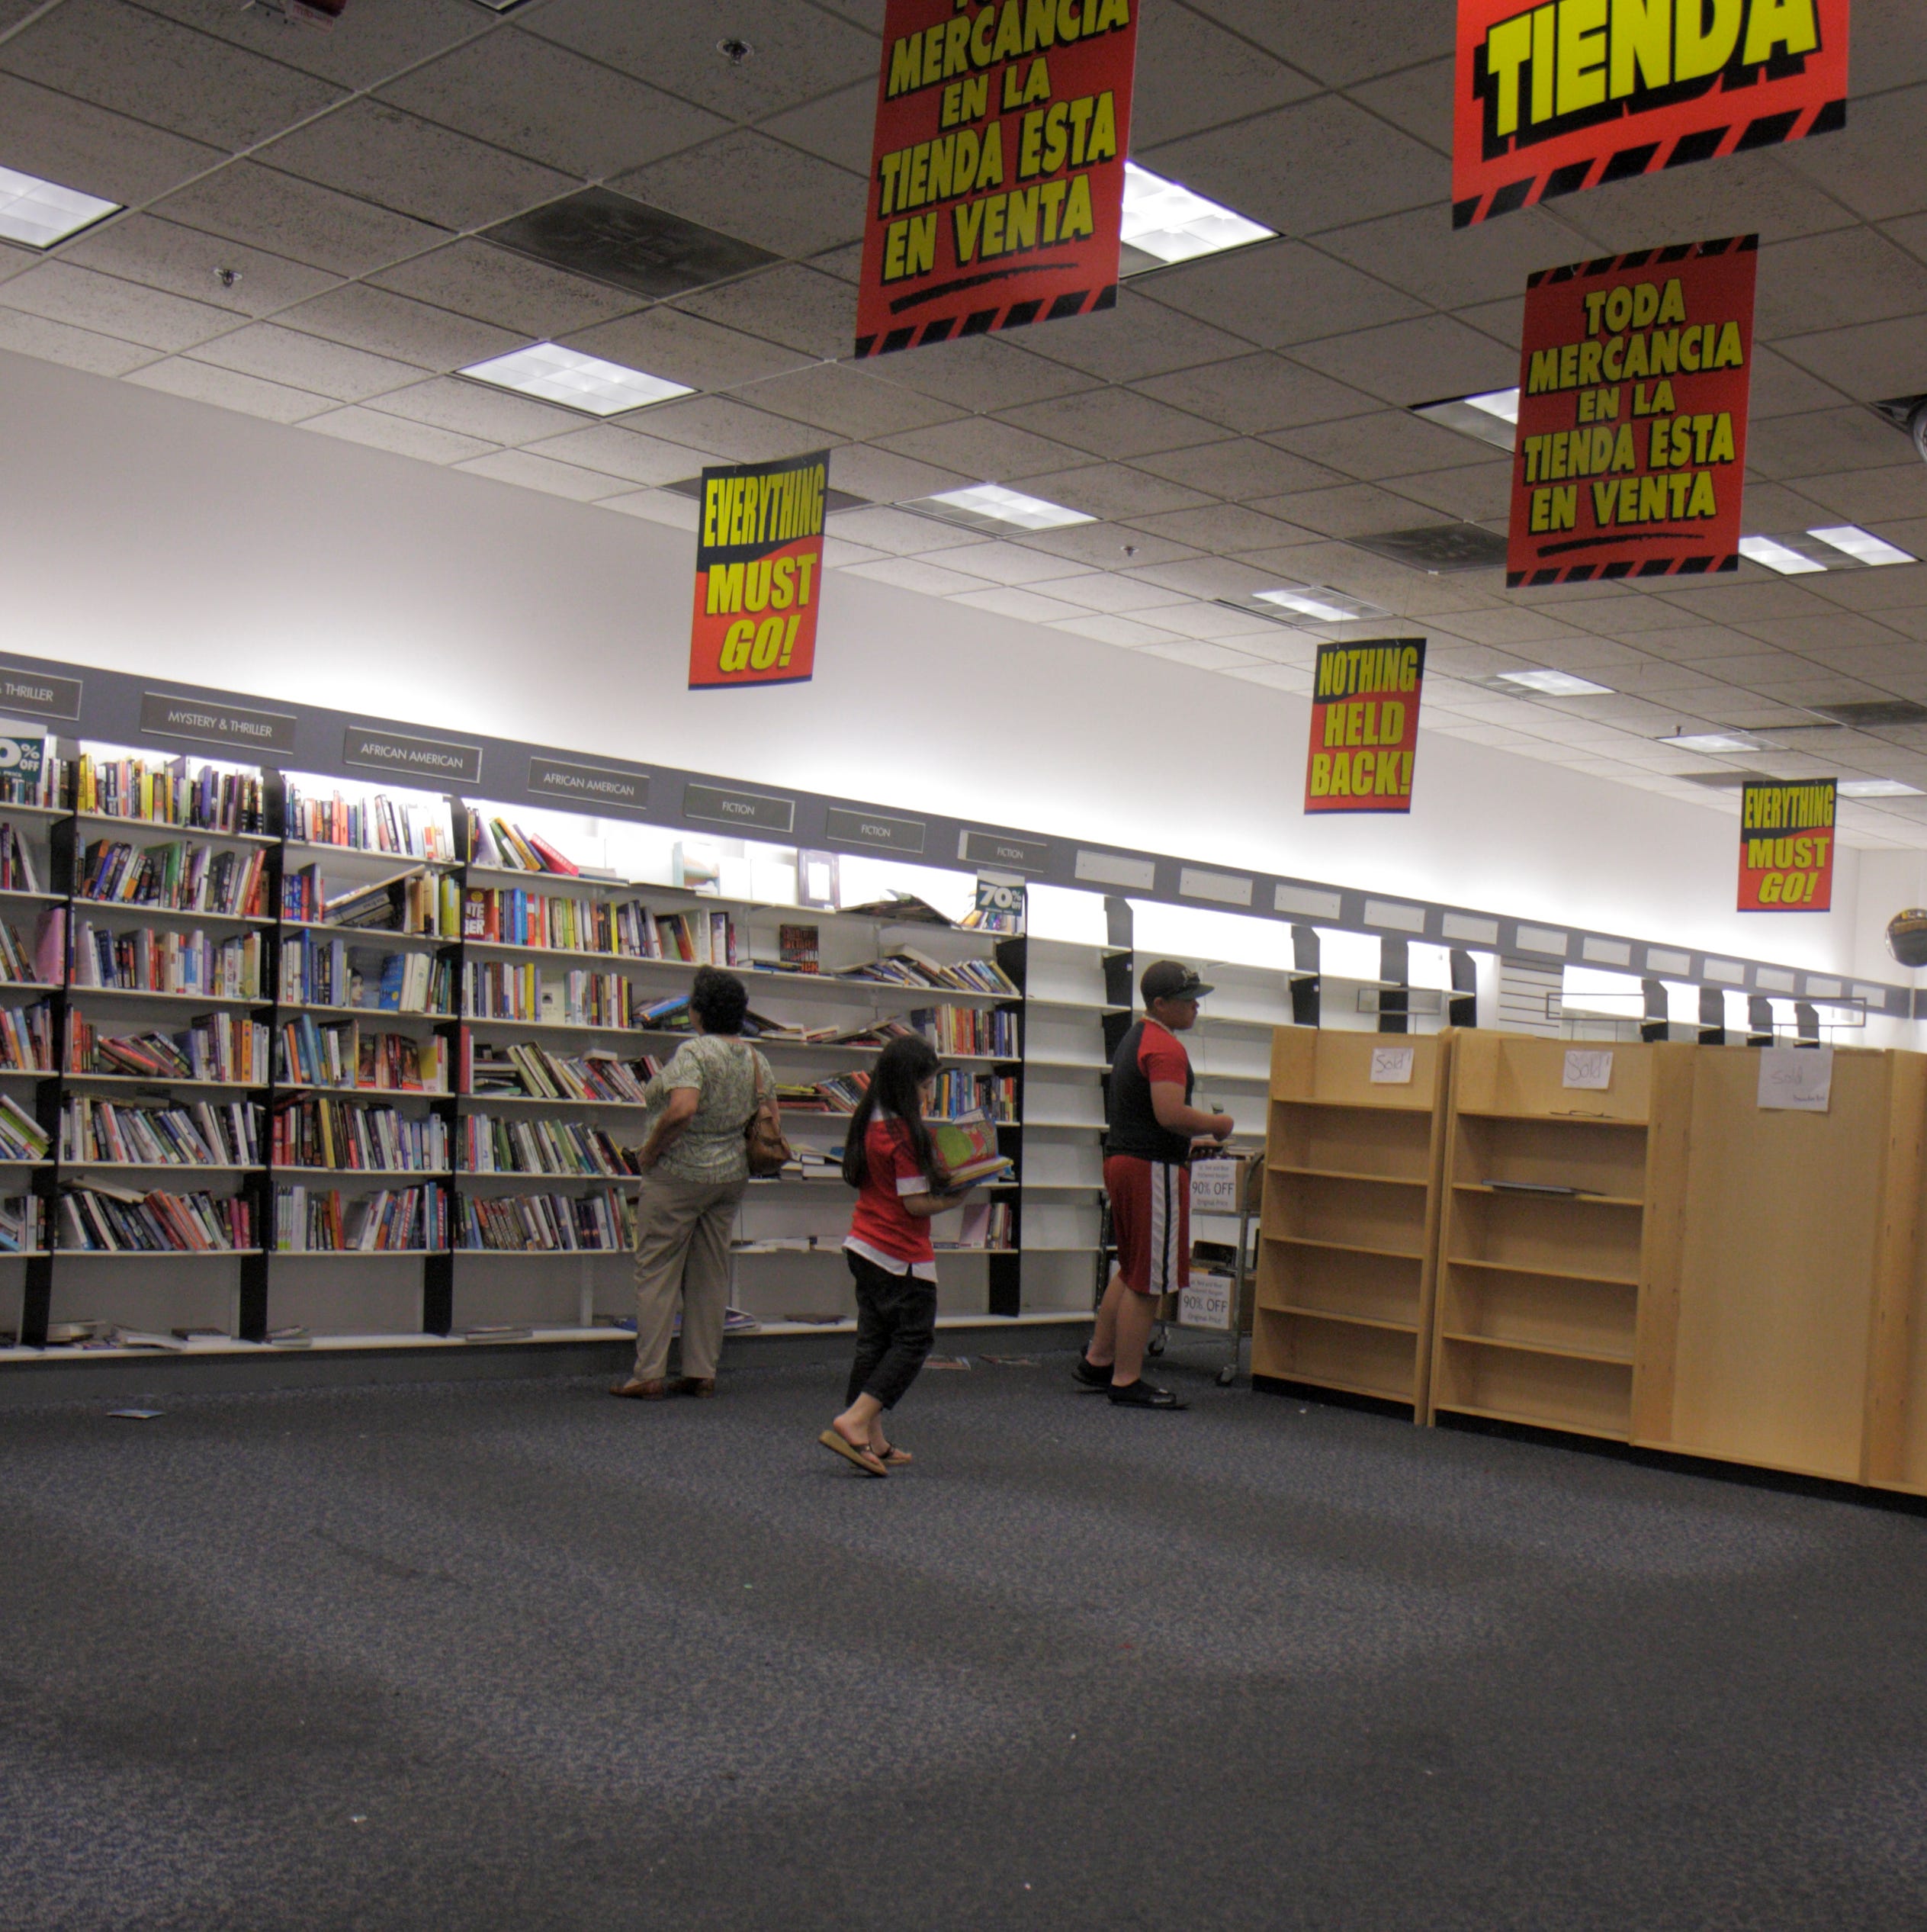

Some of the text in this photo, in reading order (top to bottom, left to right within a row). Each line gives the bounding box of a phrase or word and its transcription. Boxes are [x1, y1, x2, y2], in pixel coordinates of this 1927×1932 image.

[887, 0, 1130, 96] MERCANCIA
[941, 57, 1052, 129] EN LA
[1476, 0, 1819, 156] TIENDA
[879, 91, 1117, 217] TIENDA ESTA
[882, 174, 1094, 283] EN VENTA
[1585, 278, 1686, 337] TODA
[1527, 321, 1744, 395] MERCANCIA
[1577, 380, 1676, 424] EN LA
[1524, 413, 1735, 485] TIENDA ESTA
[702, 463, 826, 548] EVERYTHING
[1529, 471, 1717, 534] EN VENTA
[705, 553, 818, 615] MUST
[718, 614, 801, 673] GO!
[5, 683, 53, 702] THRILLER
[1318, 646, 1418, 696] NOTHING
[168, 712, 273, 738] MYSTERY & THRILLER
[1323, 701, 1405, 747] HELD
[19, 759, 40, 772] OFF
[360, 742, 464, 769] AFRICAN AMERICAN
[1309, 751, 1414, 797] BACK!
[543, 773, 634, 796] AFRICAN AMERICAN
[1743, 784, 1835, 829] EVERYTHING
[722, 801, 755, 815] FICTION
[861, 824, 891, 837] FICTION
[997, 846, 1023, 860] FICTION
[1746, 837, 1830, 869] MUST
[1758, 872, 1819, 904] GO!
[1192, 1181, 1234, 1195] 90% OFF
[1183, 1294, 1227, 1313] 90% OFF
